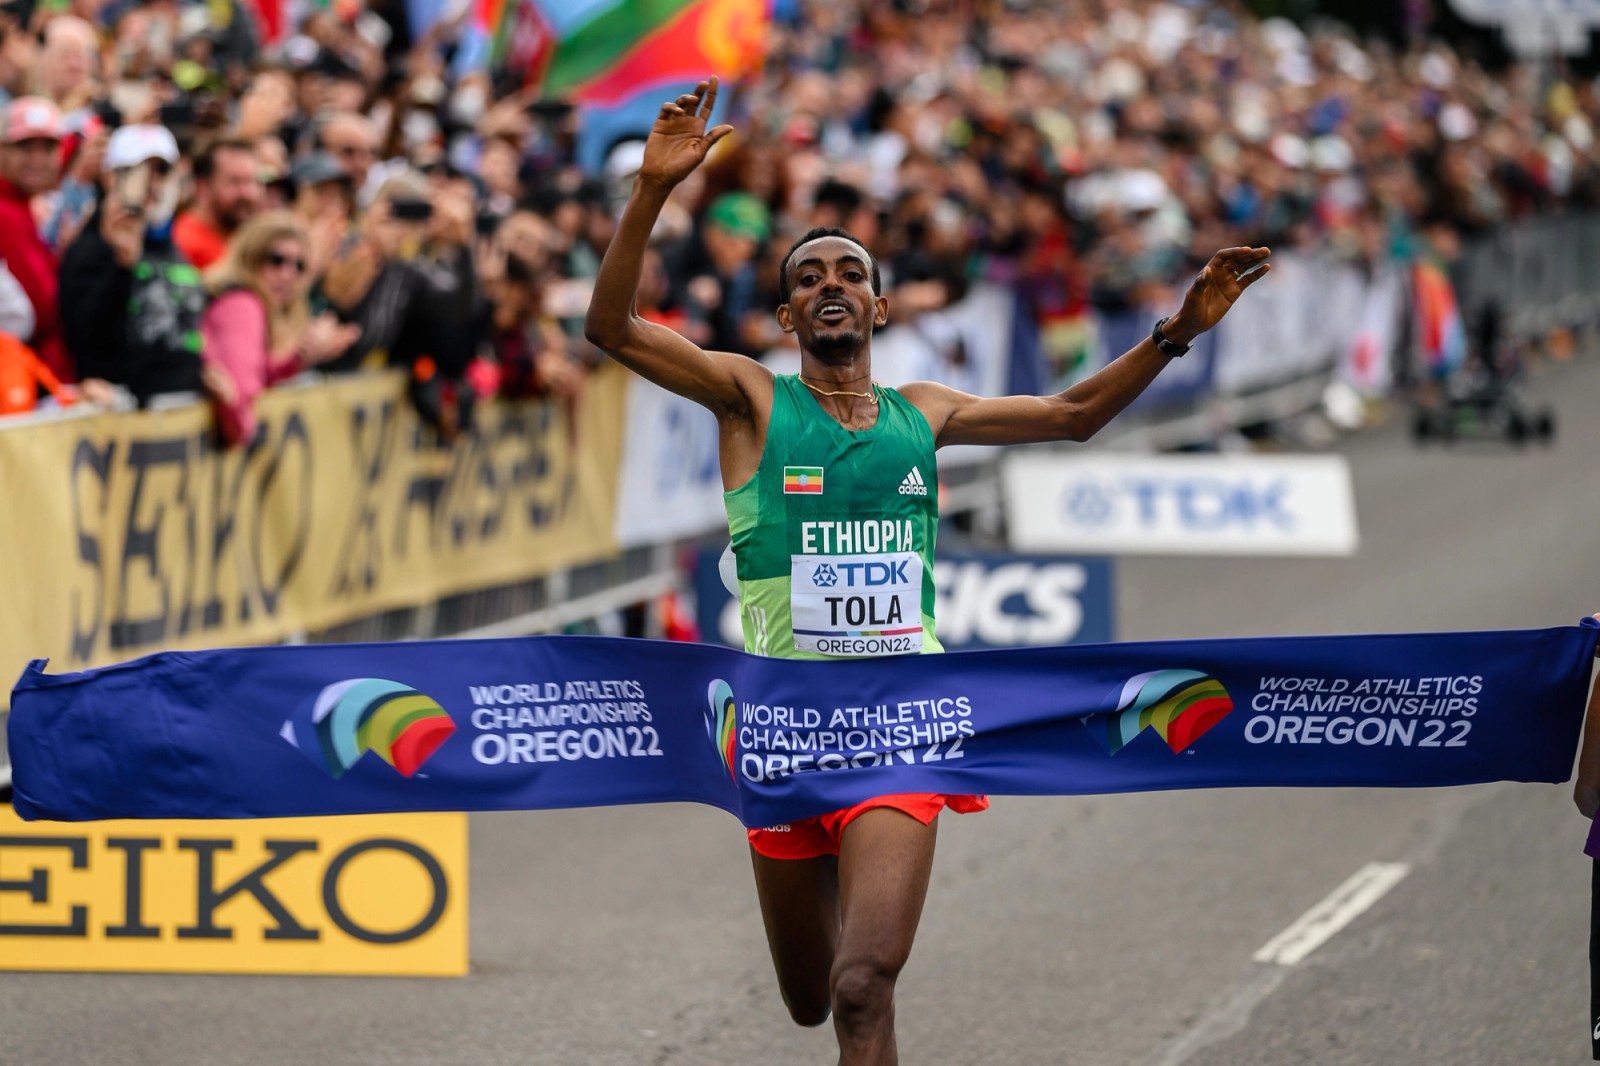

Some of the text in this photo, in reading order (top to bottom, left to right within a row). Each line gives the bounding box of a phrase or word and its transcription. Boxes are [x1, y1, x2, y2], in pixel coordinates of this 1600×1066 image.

[898, 481, 928, 496] adidas
[1116, 474, 1298, 534] TDK
[801, 519, 913, 554] ETHIOPIA
[837, 560, 909, 587] TDK
[824, 594, 903, 626] TOLA
[816, 637, 911, 653] OREGON22
[469, 680, 645, 706] WORLD ATHLETICS
[1258, 675, 1483, 696] WORLD ATHLETICS
[470, 701, 653, 730] CHAMPIONSHIPS
[742, 696, 972, 729] WORLD ATHLETICS
[1251, 692, 1479, 717] CHAMPIONSHIPS
[471, 725, 665, 765] OREGON22
[739, 719, 976, 752] CHAMPIONSHIPS
[0, 836, 449, 944] EIKO
